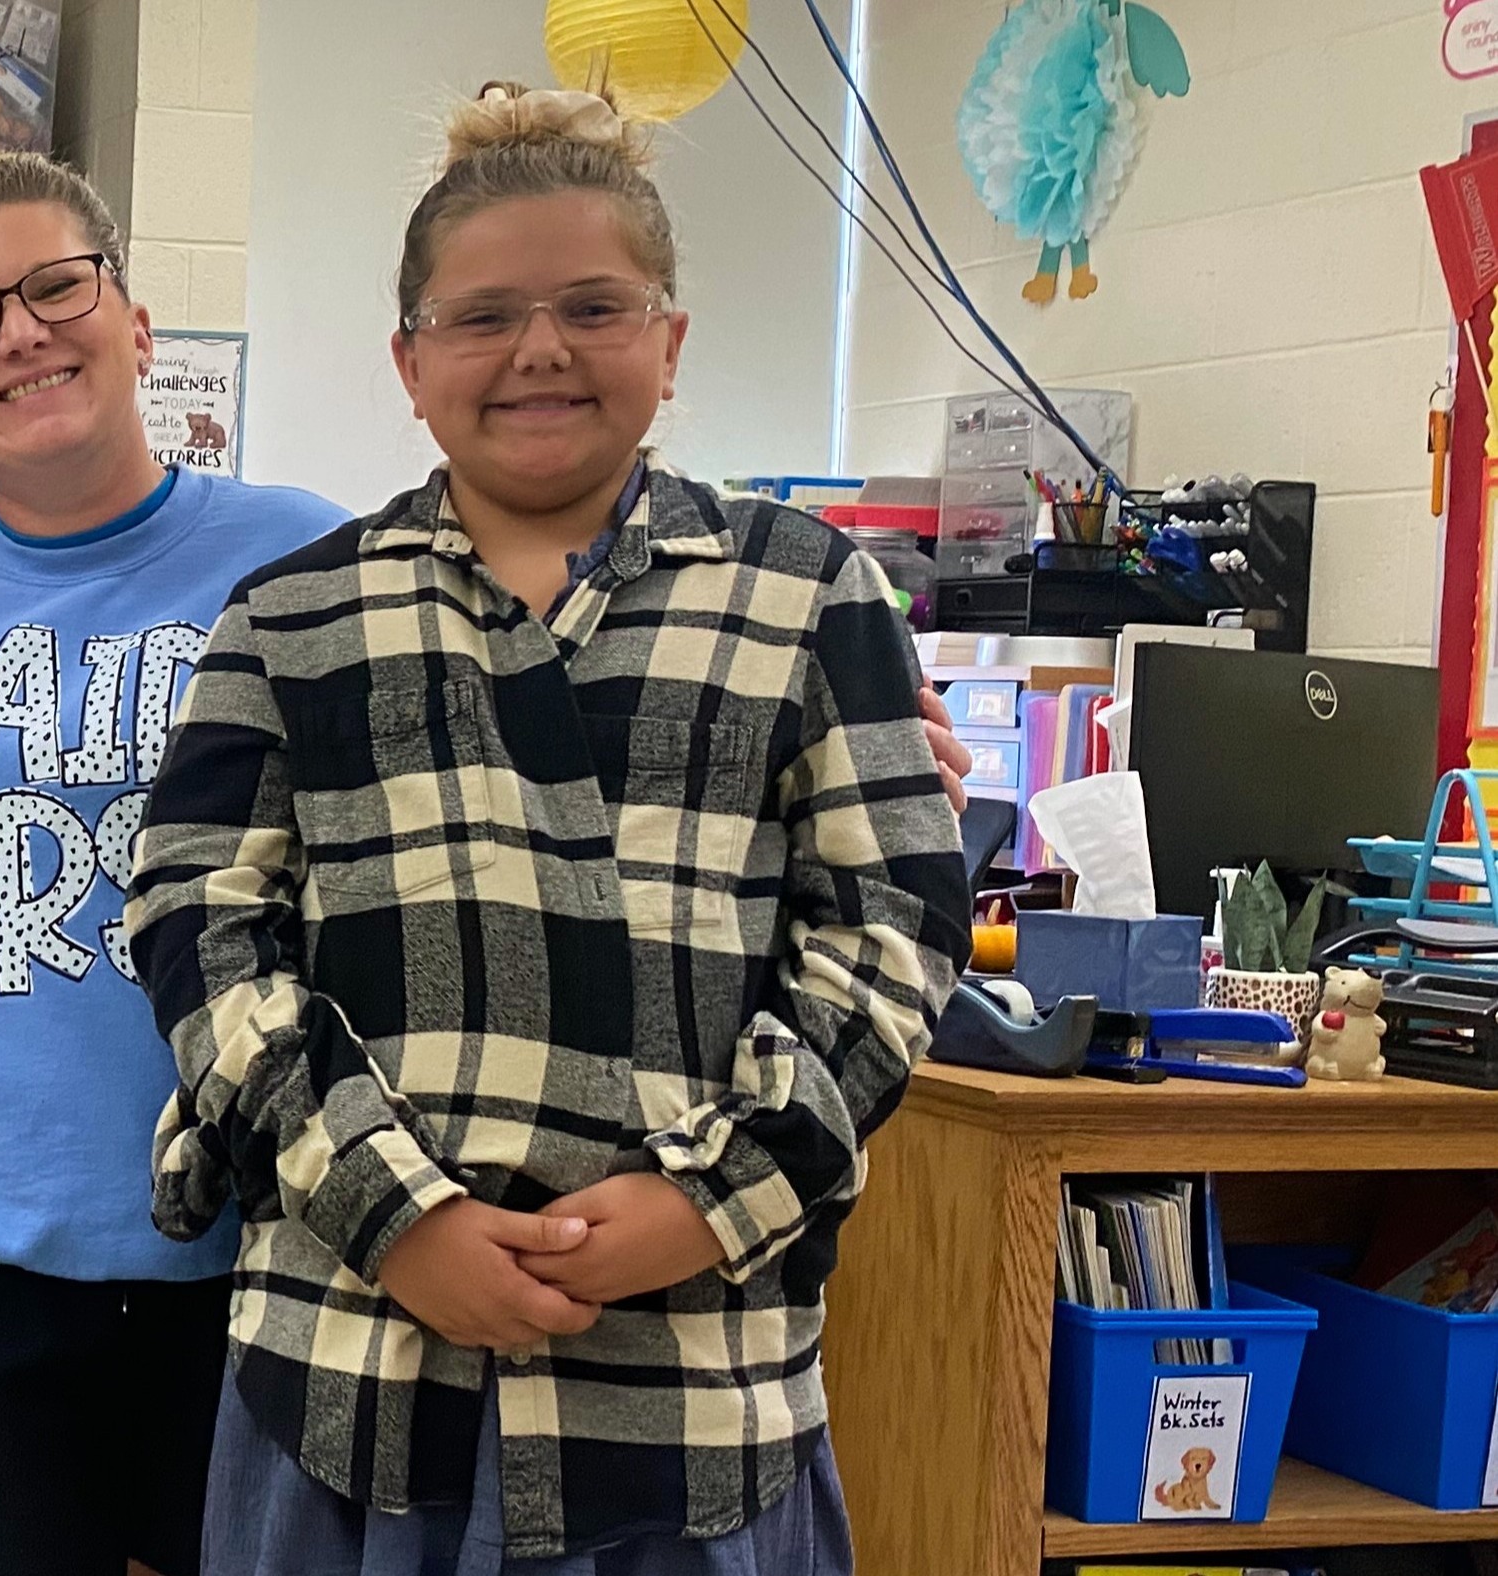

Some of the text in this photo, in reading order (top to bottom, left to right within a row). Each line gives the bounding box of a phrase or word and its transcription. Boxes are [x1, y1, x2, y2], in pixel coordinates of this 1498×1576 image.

[163, 397, 202, 409] TODAY
[142, 411, 182, 429] ead to
[1310, 687, 1334, 702] DELL
[1163, 1391, 1222, 1411] Winter
[1160, 1411, 1226, 1430] Bk. Sets
